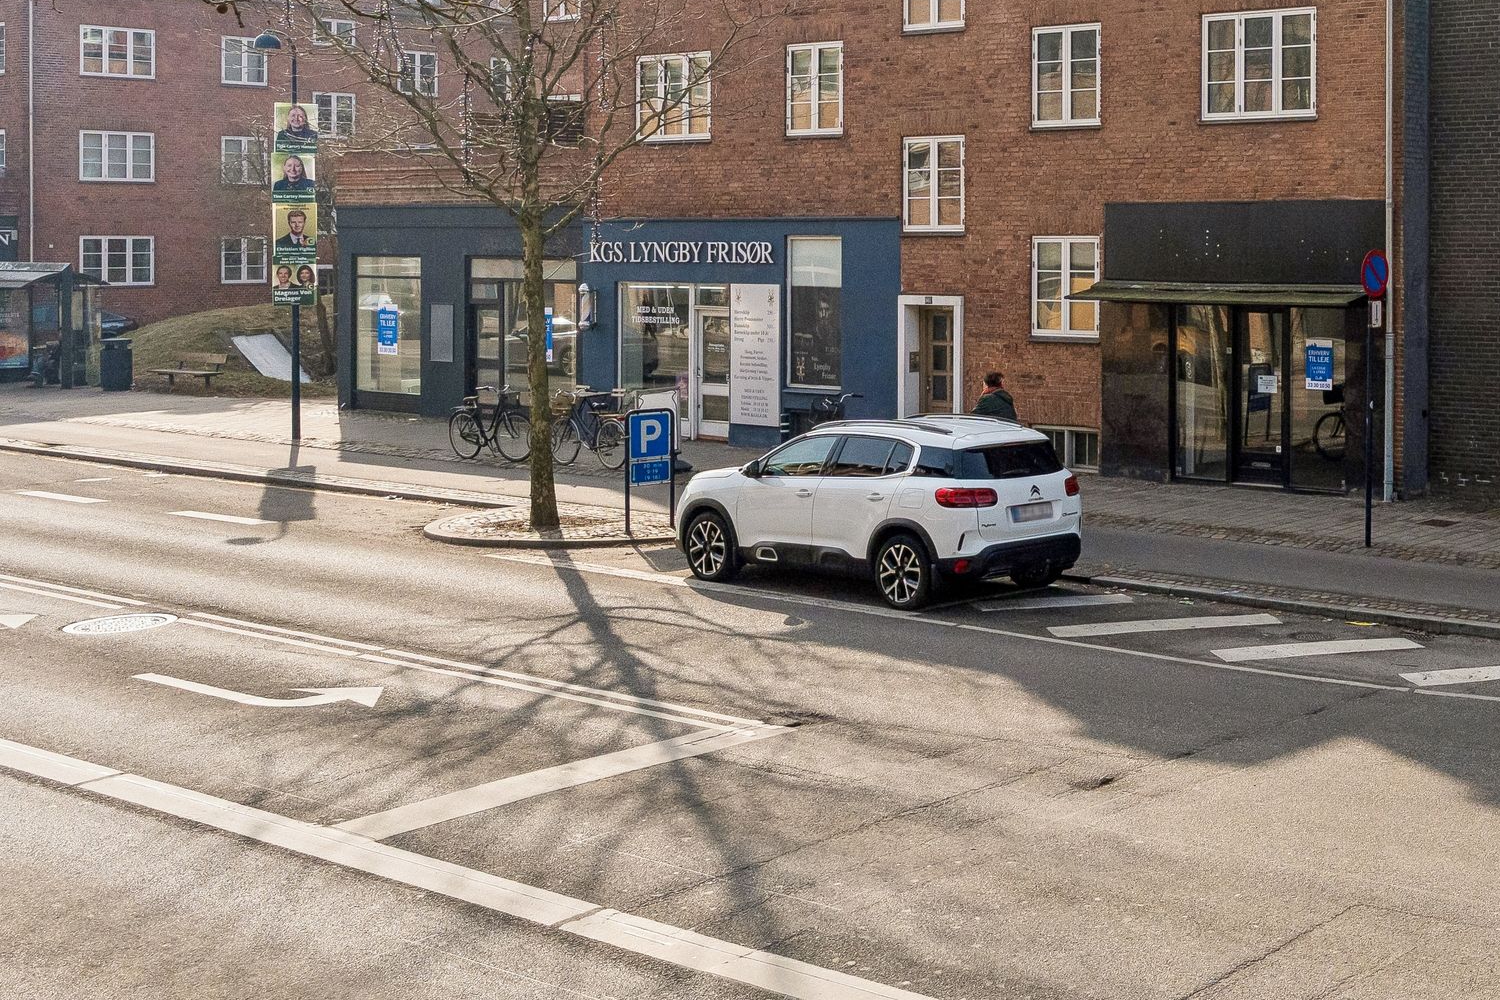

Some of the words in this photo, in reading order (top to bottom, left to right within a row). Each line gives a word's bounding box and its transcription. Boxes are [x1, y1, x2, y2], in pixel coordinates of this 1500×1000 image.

[589, 241, 627, 263] KGS.
[629, 241, 704, 264] LYNGBY
[706, 241, 774, 264] FRISØR
[632, 316, 680, 324] TIDSBESTILLING
[641, 420, 661, 453] P
